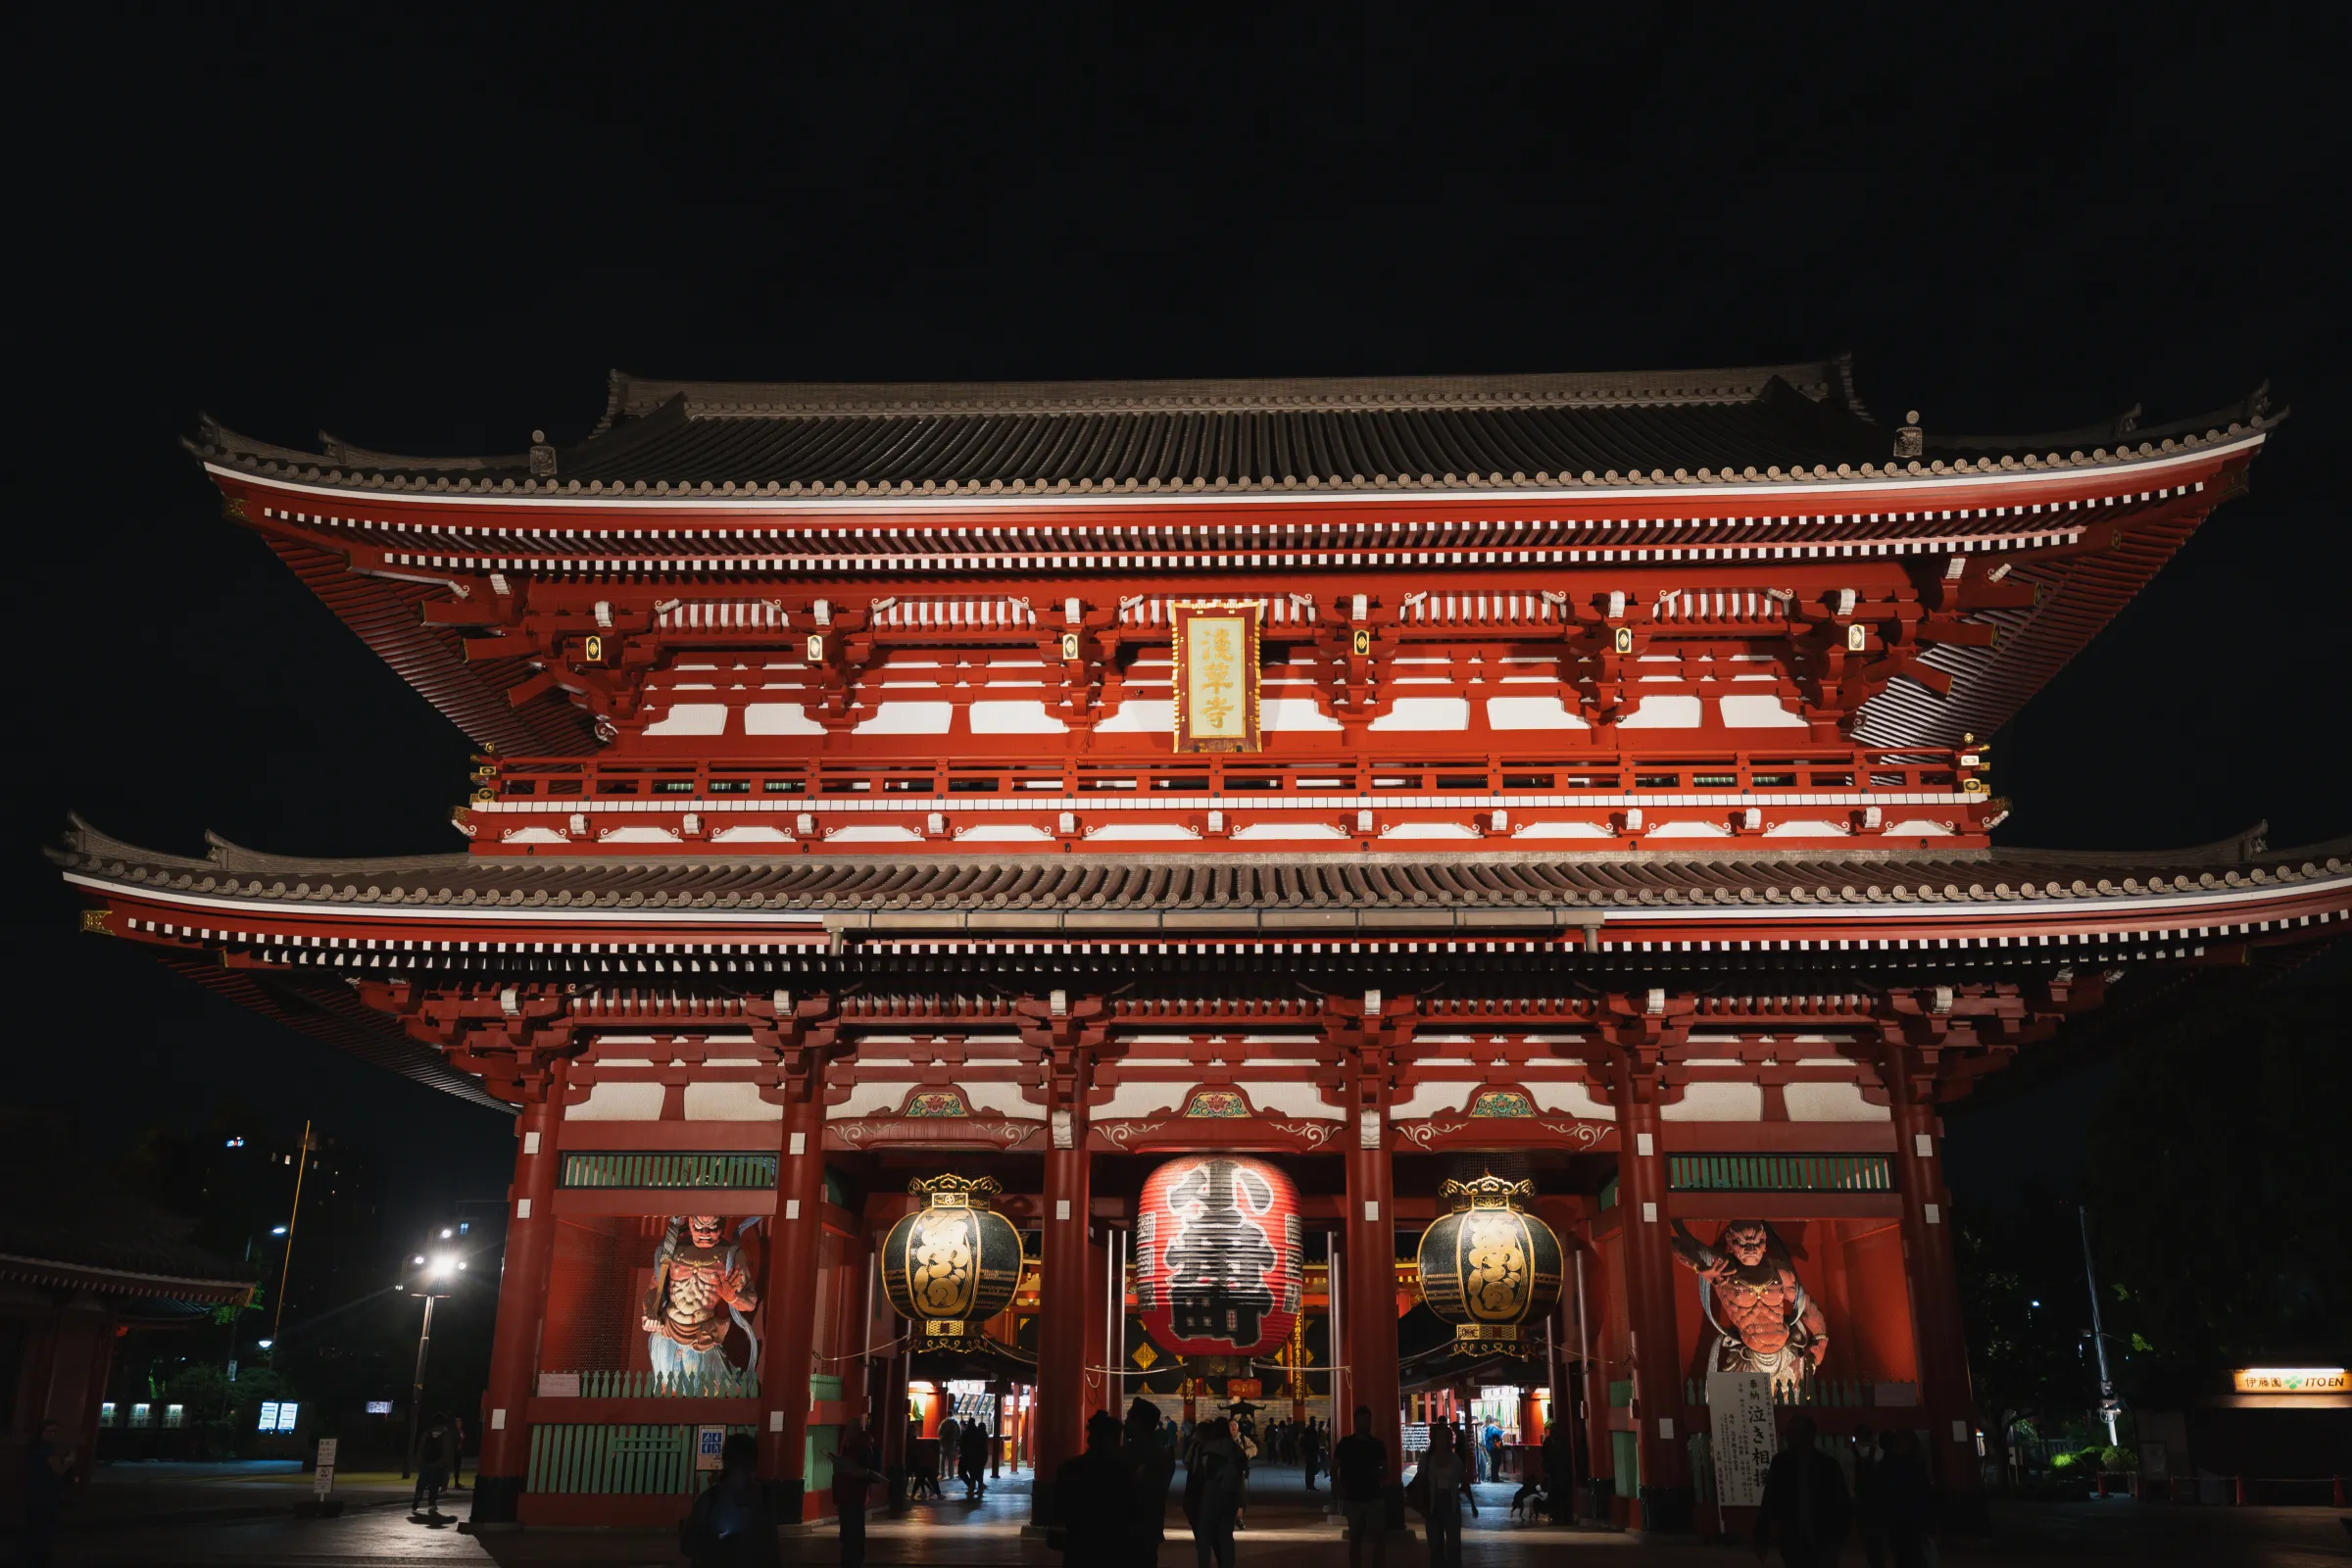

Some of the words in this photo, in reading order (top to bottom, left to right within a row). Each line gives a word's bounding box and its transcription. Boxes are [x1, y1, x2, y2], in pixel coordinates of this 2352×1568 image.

[1163, 1159, 1278, 1348] 小舟町
[2245, 1377, 2281, 1388] 伊藤園
[2305, 1377, 2326, 1387] ITO
[2328, 1377, 2344, 1387] EN
